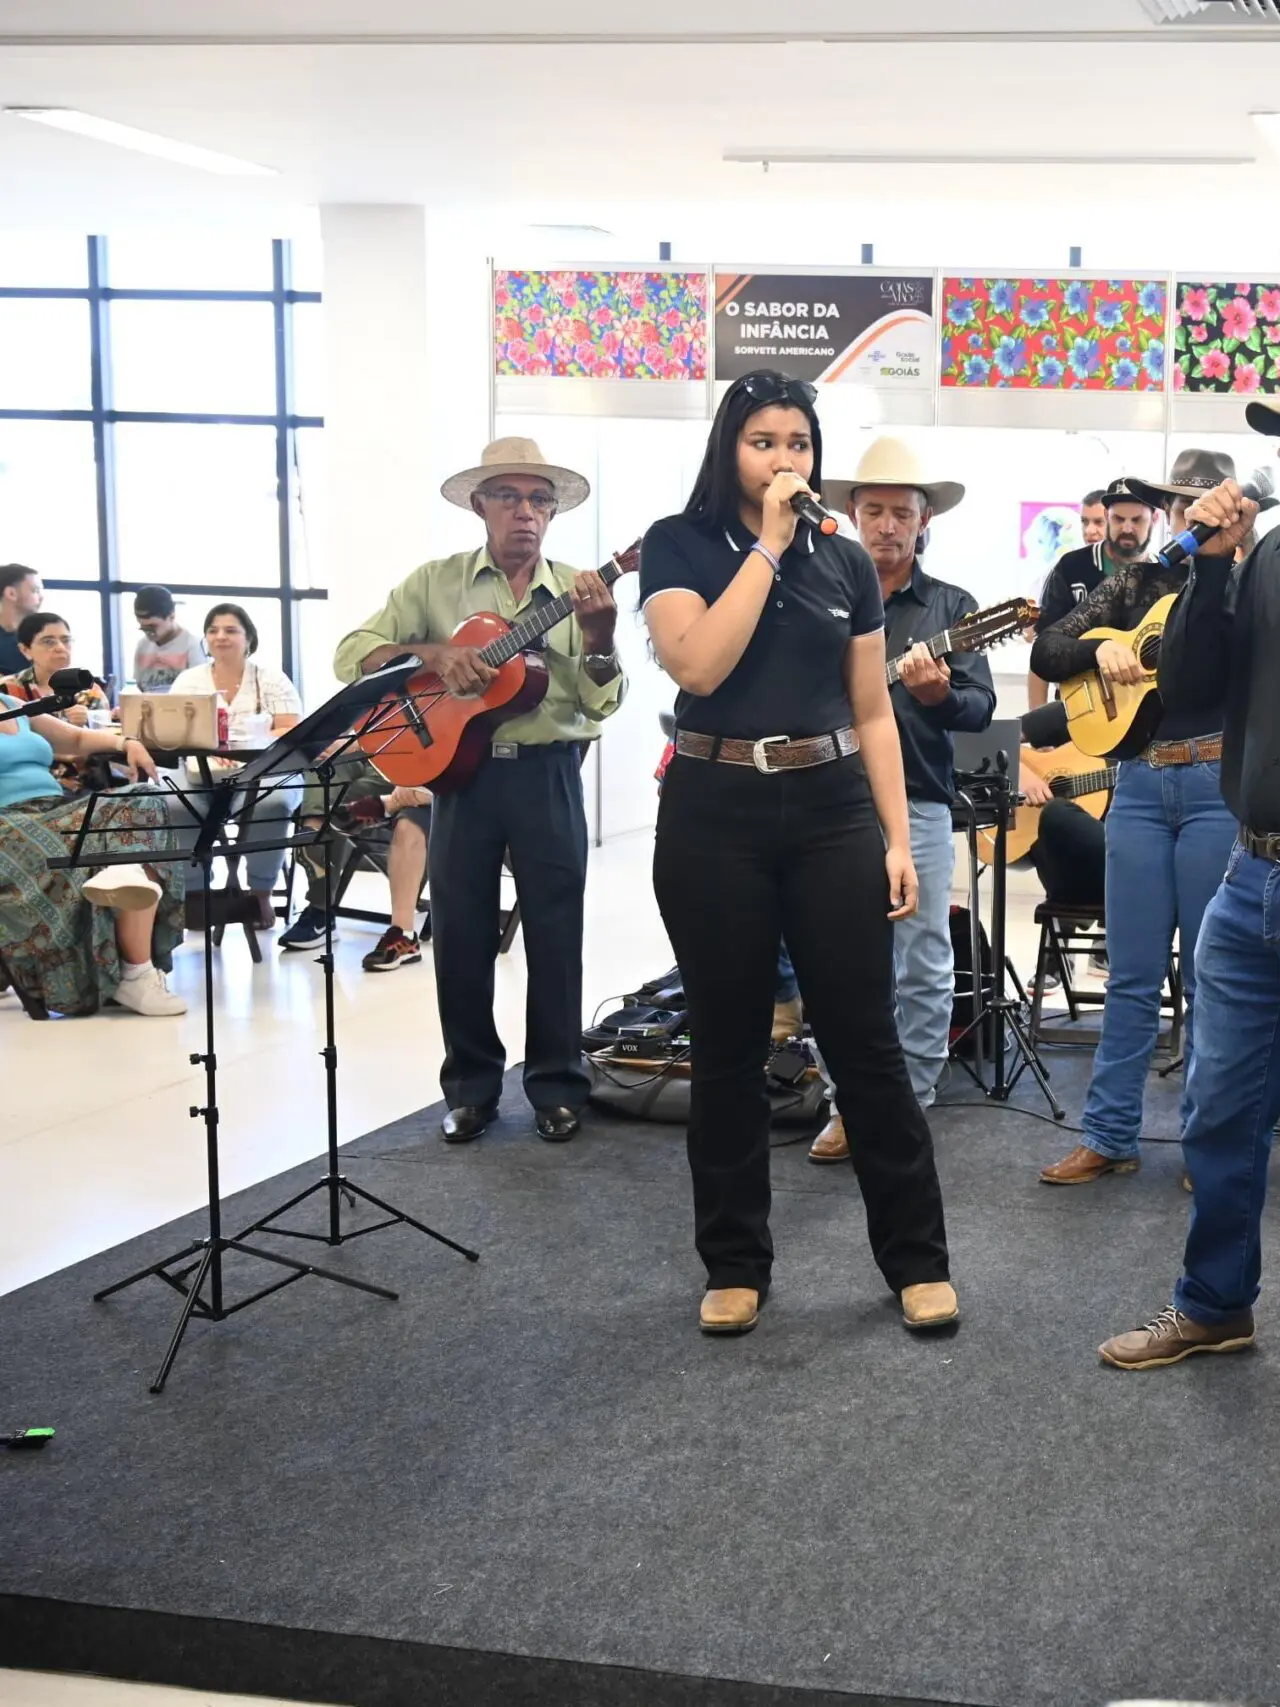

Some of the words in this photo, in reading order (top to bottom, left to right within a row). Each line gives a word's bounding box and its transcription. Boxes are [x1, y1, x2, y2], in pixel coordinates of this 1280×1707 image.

[725, 302, 740, 316] O
[744, 302, 809, 317] SABOR
[813, 303, 840, 318] DA
[740, 320, 830, 340] INFÂNCIA
[735, 346, 777, 355] SORVETE
[779, 346, 835, 356] AMERICANO
[888, 366, 920, 376] GOIÁS
[622, 1044, 639, 1052] VOX
